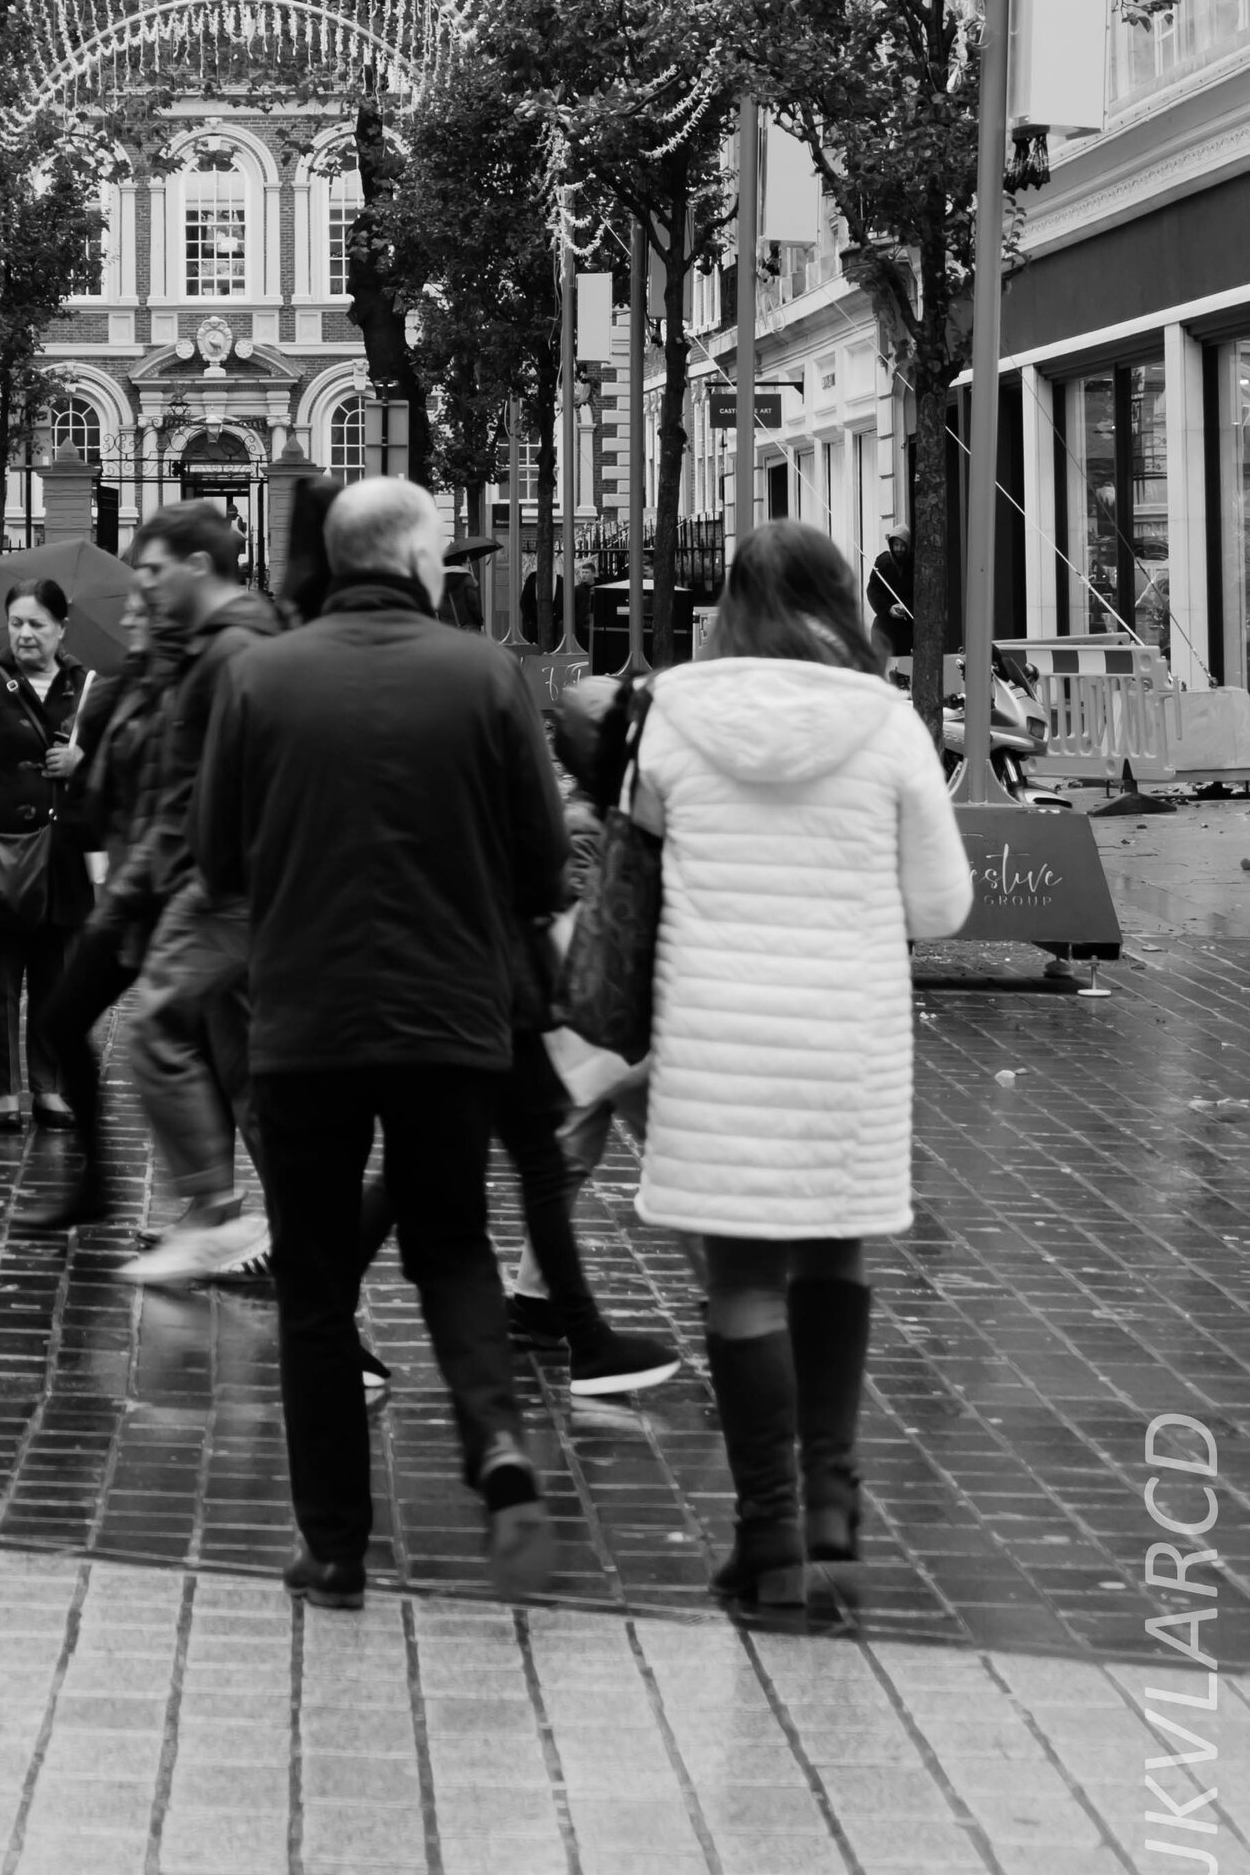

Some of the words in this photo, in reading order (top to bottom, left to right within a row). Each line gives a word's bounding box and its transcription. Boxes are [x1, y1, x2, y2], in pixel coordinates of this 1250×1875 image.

[719, 407, 737, 415] CAST
[759, 407, 772, 415] ART
[967, 834, 1062, 895] estive
[983, 894, 1052, 907] GROUP
